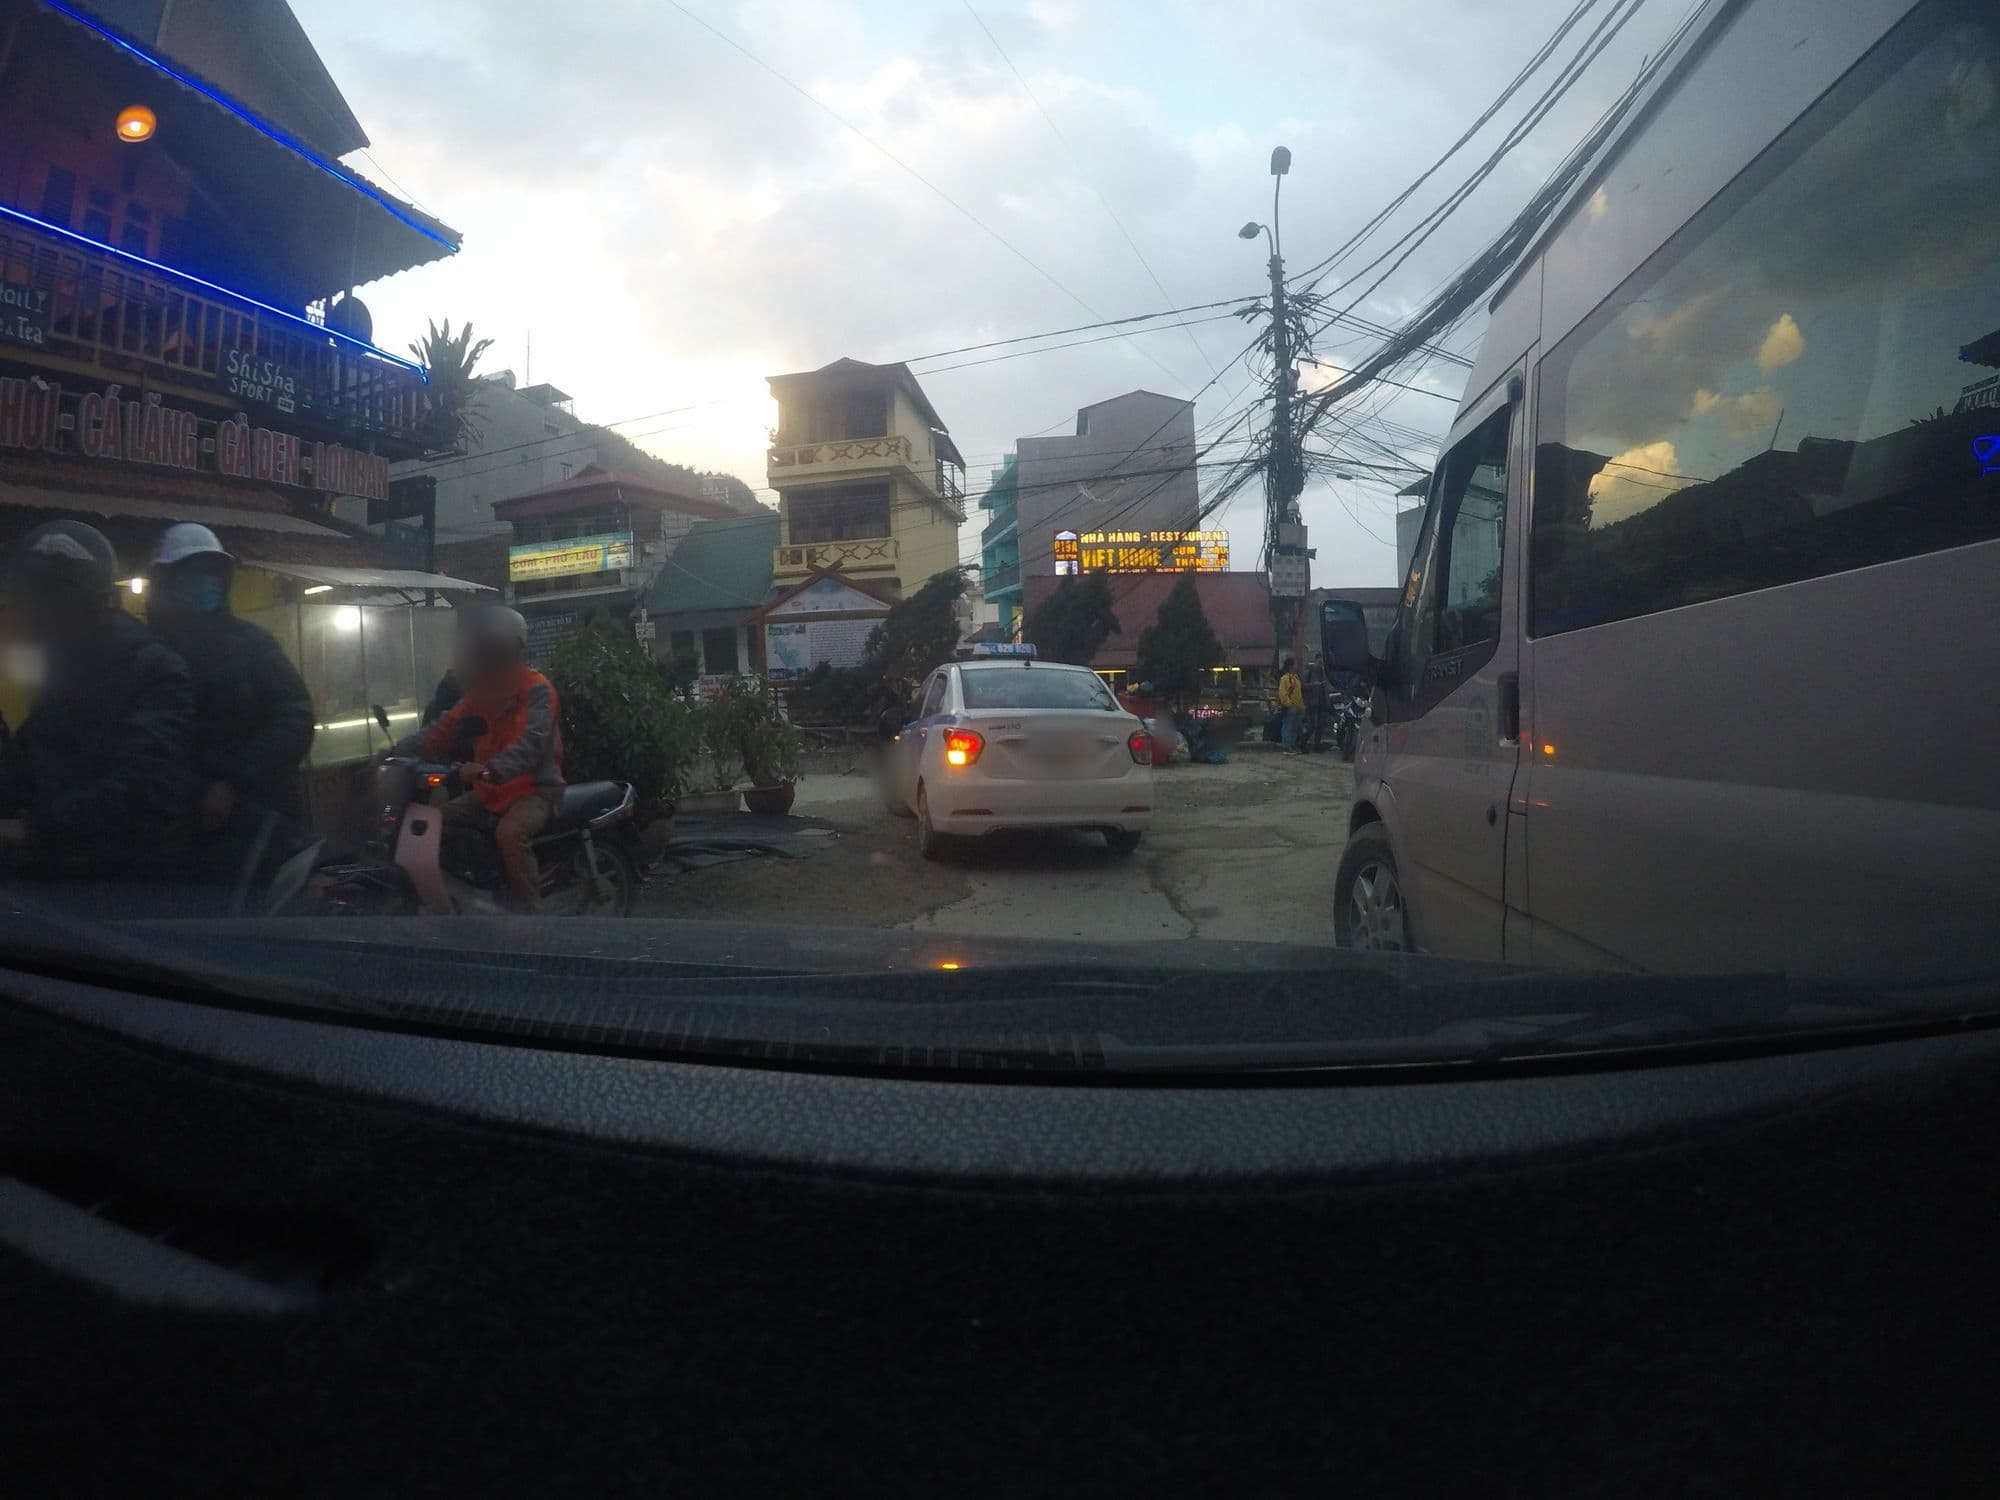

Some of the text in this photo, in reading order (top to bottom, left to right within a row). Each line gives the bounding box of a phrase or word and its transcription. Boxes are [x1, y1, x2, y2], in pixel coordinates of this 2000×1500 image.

[16, 315, 43, 344] Tea
[229, 377, 273, 402] SPORT
[1150, 531, 1227, 542] RESTAURANT
